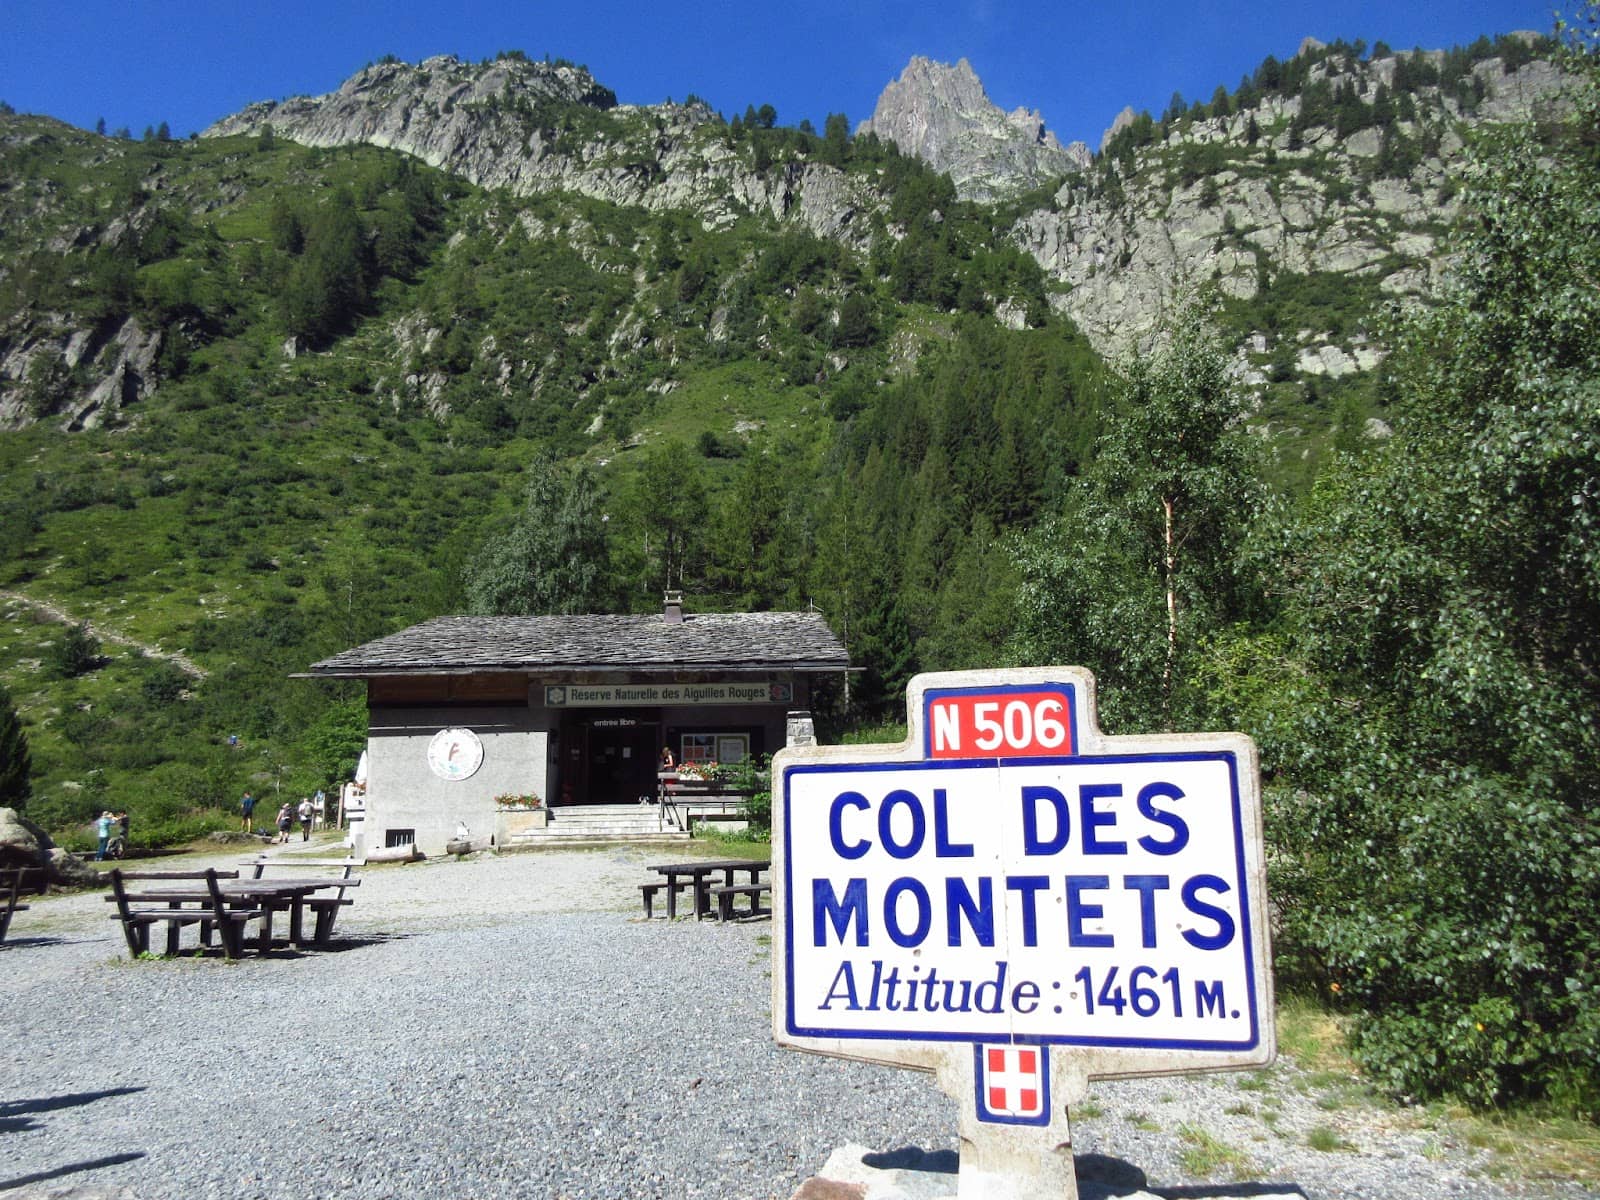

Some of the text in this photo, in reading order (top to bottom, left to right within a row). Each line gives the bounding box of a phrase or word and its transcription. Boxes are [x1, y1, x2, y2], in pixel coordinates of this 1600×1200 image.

[615, 687, 658, 700] Naturelle
[662, 687, 679, 699] des
[683, 686, 725, 702] Aiguilles
[729, 686, 765, 701] Rouges
[933, 698, 1066, 751] N 506
[829, 781, 1190, 860] COL DES
[812, 874, 1236, 951] MONTETS
